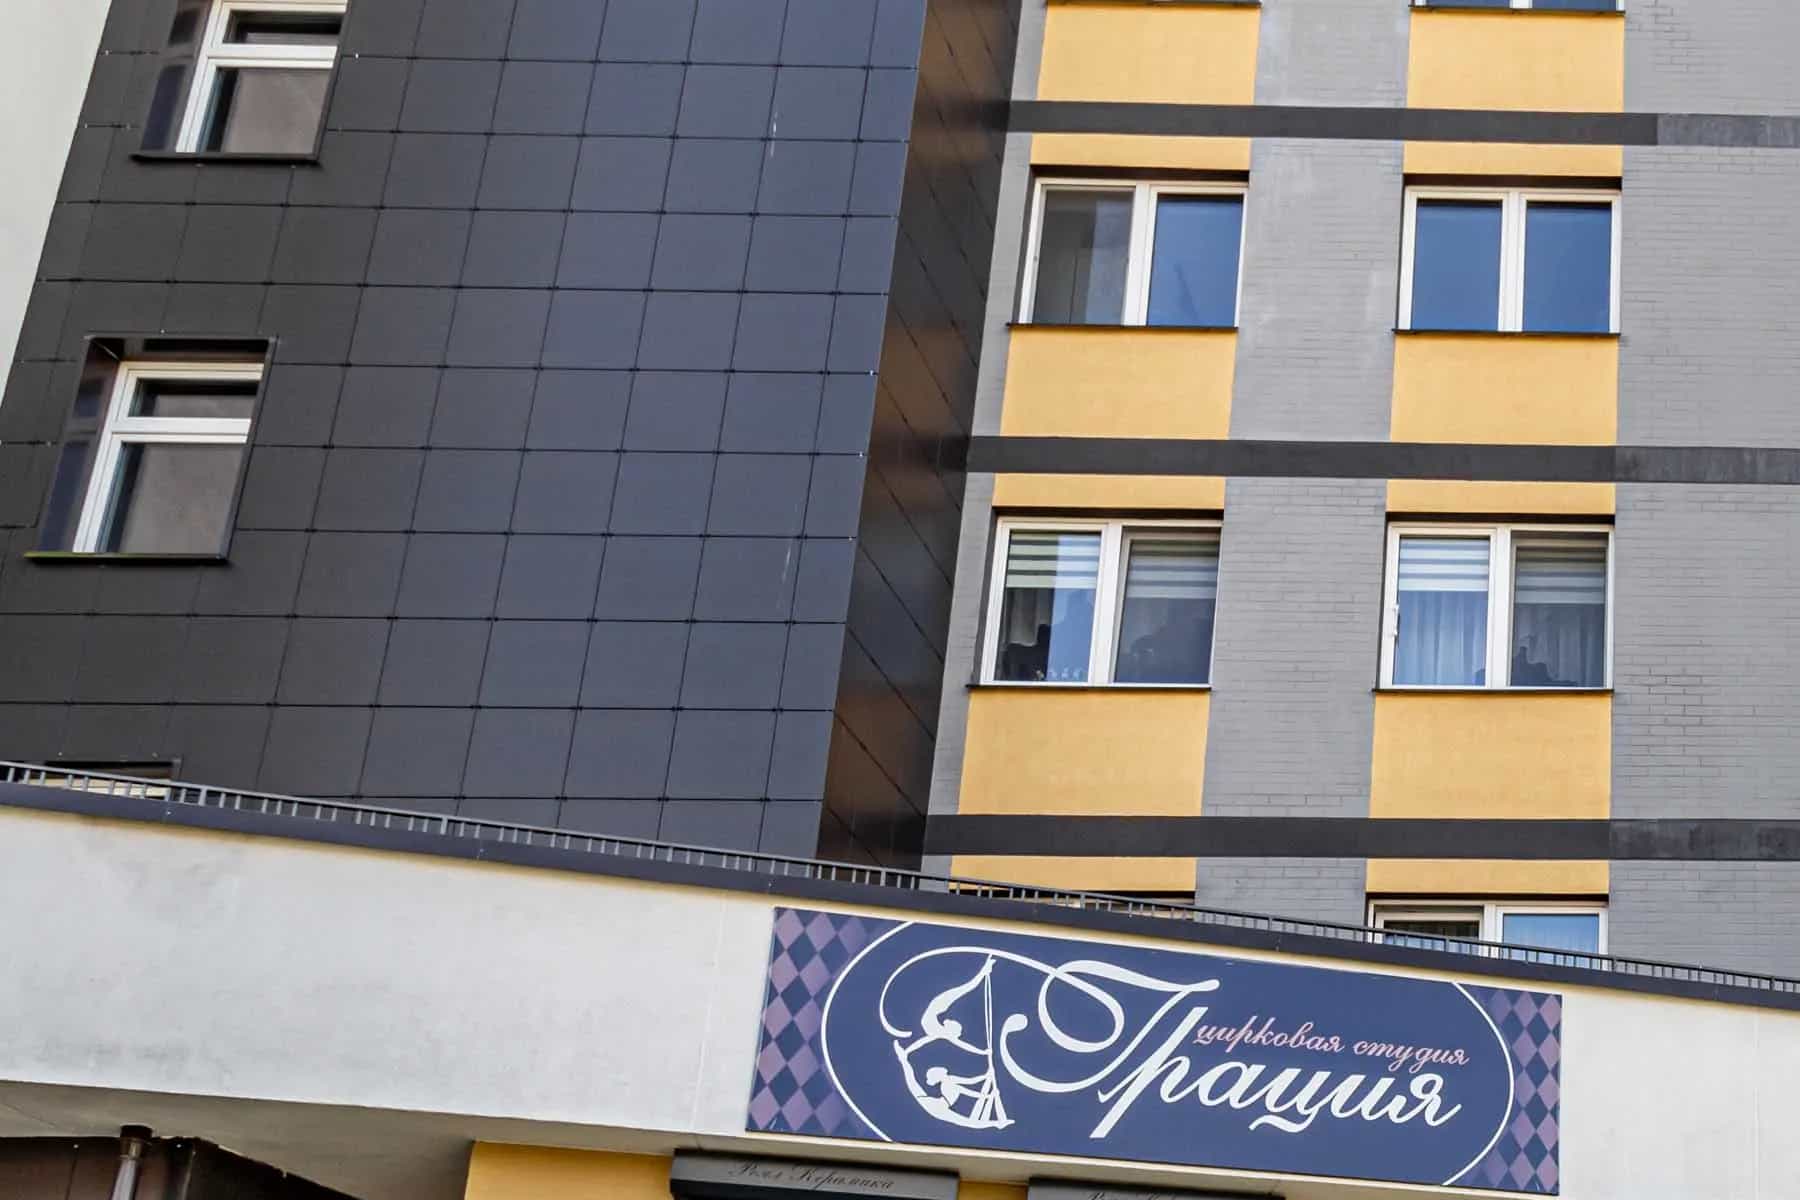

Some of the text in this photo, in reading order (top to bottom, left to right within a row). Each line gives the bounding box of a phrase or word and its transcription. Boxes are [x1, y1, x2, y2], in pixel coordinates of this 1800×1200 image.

[1000, 958, 1462, 1139] Грация
[1196, 1013, 1471, 1074] цирковая студия
